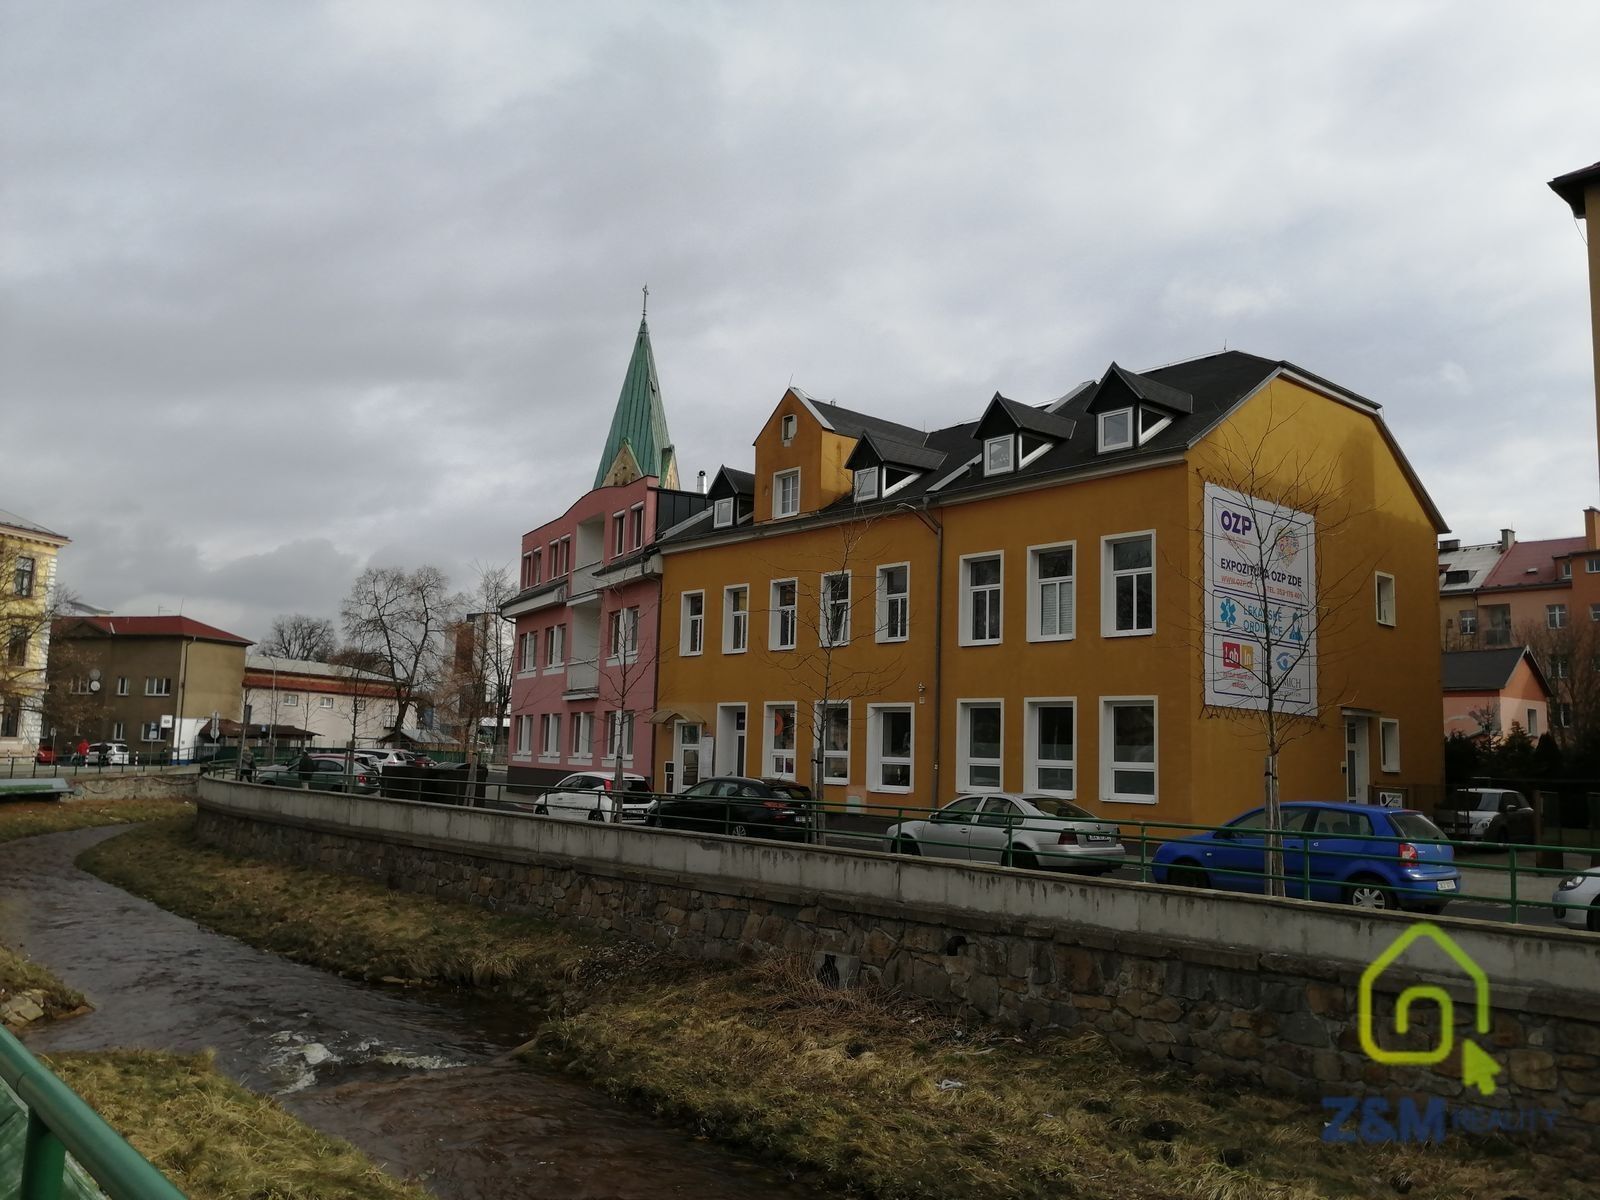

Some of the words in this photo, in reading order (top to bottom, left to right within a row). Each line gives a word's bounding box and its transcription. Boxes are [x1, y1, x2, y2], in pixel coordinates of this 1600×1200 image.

[1221, 510, 1252, 535] OZP
[1271, 570, 1287, 584] OZP
[1287, 575, 1302, 587] ZDE
[1243, 603, 1282, 622] LÉKASKÉ
[1243, 619, 1282, 637] ORDICE
